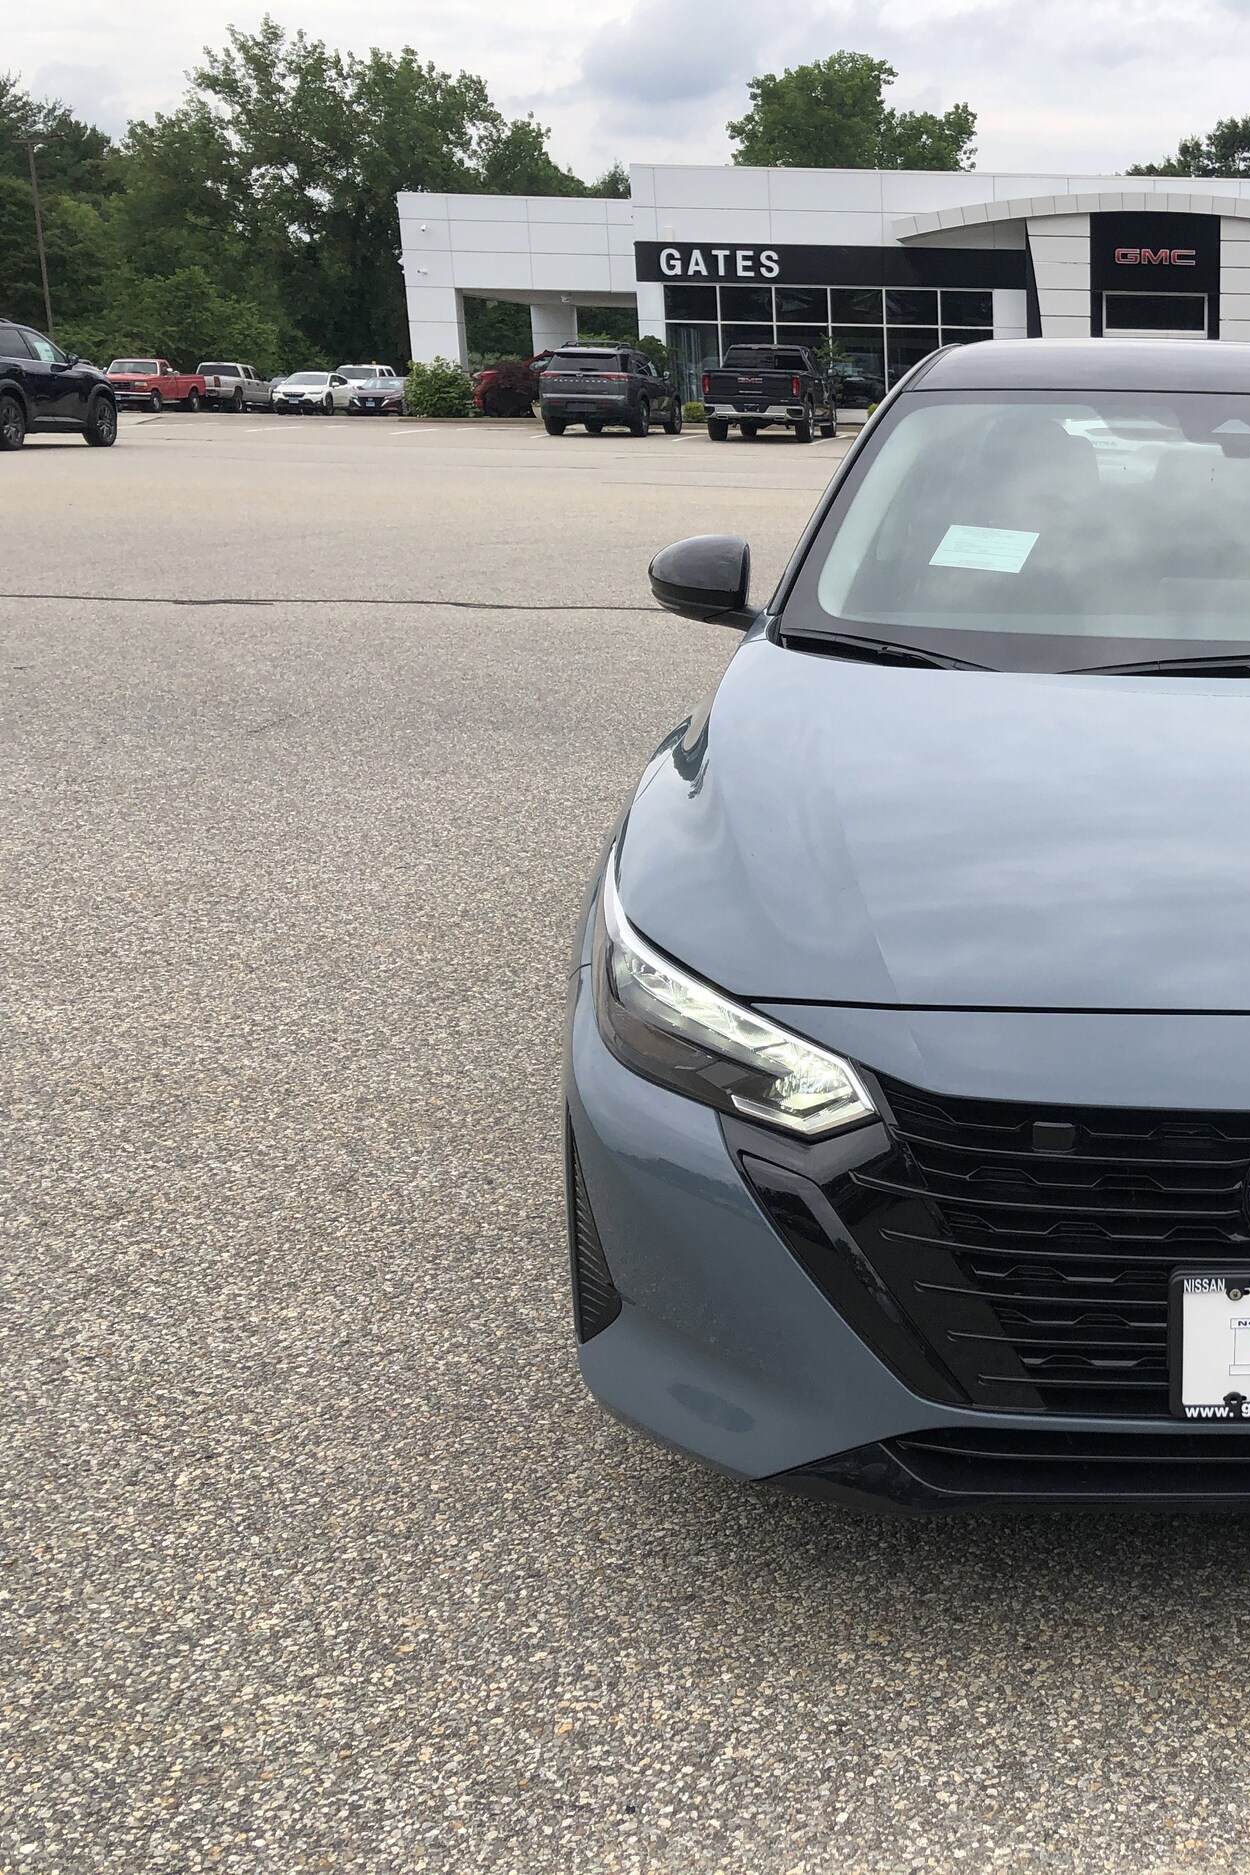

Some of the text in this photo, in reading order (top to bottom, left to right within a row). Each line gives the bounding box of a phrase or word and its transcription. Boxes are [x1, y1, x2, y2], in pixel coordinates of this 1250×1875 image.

[659, 248, 780, 278] GATES
[1115, 248, 1196, 265] GMC
[1183, 1278, 1226, 1293] NISSAN
[1185, 1407, 1234, 1418] www.
